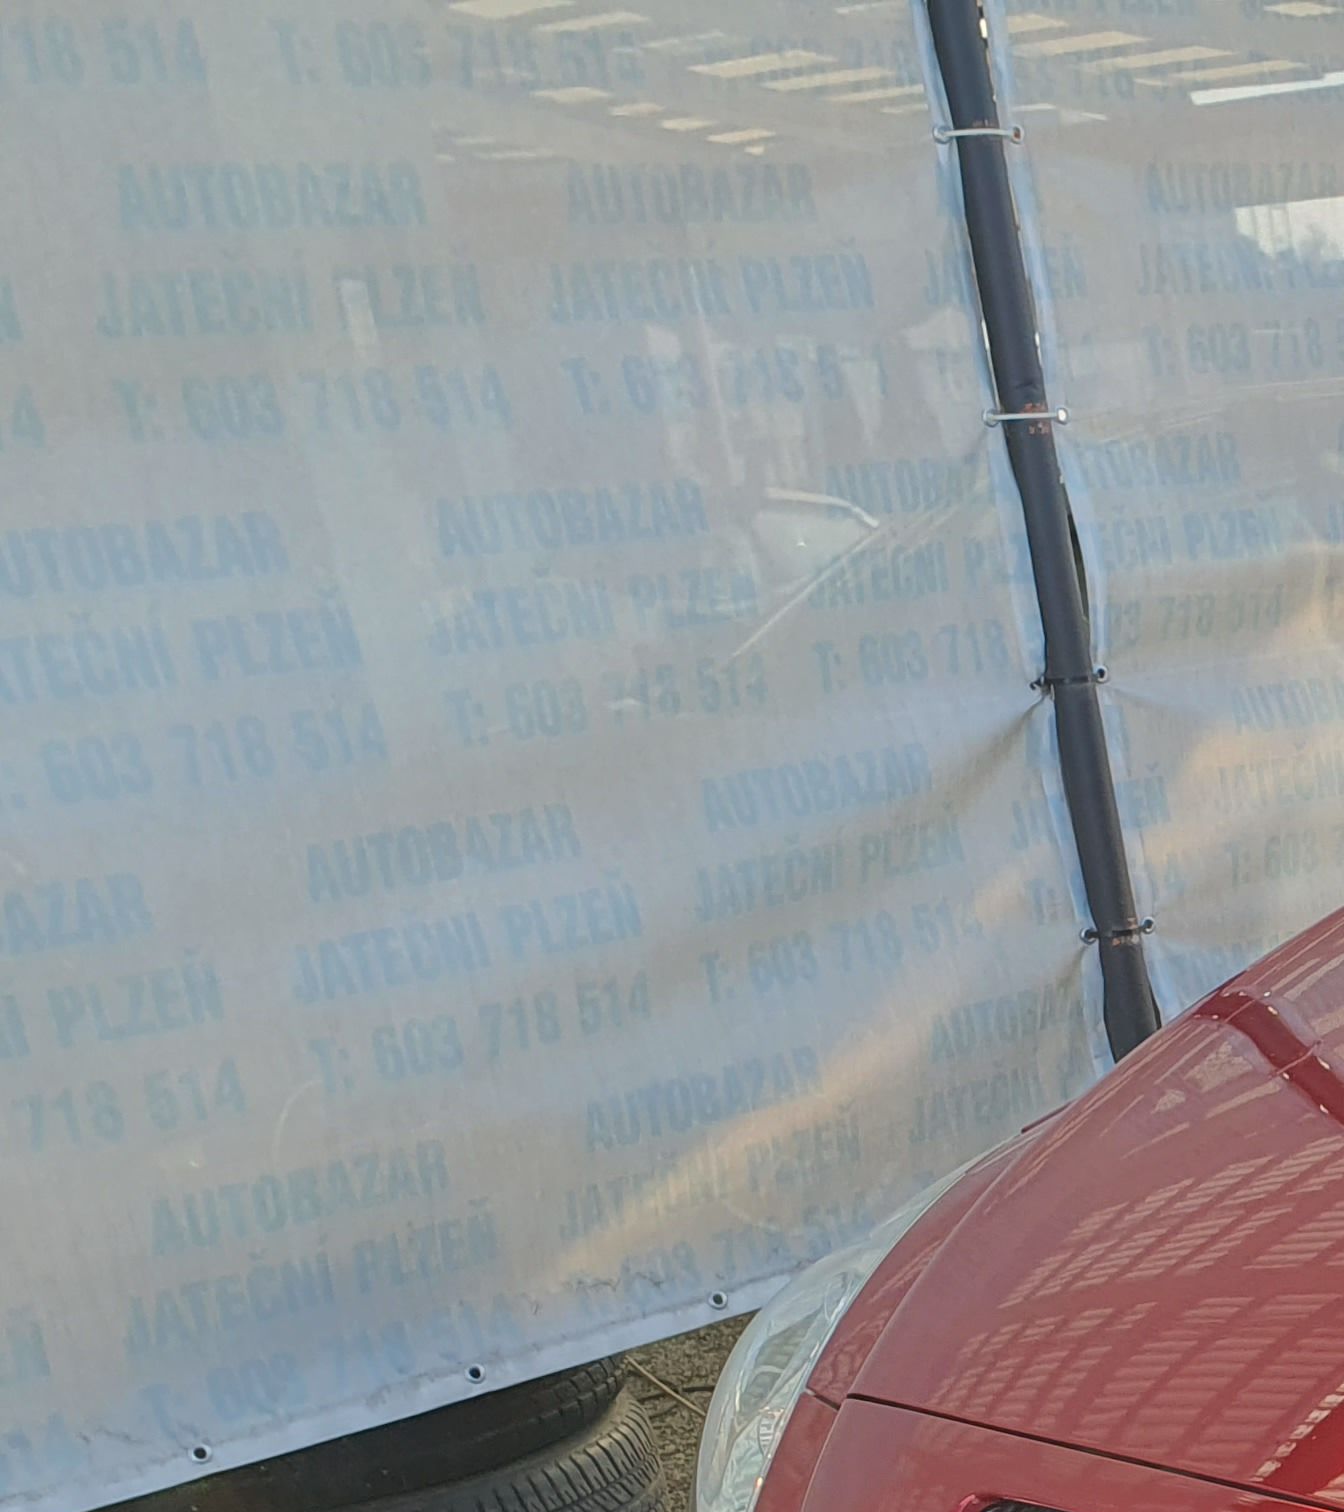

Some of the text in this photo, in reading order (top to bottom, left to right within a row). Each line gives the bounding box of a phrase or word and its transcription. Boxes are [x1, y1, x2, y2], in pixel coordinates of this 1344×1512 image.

[0, 16, 208, 86] 18 514
[268, 18, 320, 86] T:
[335, 18, 432, 89] 603
[117, 160, 430, 230] AUTOBAZAR
[566, 162, 818, 224] AUTOBAZAR
[1187, 323, 1252, 373] 603
[180, 370, 287, 442] 603
[298, 368, 402, 432] 718
[413, 363, 514, 431] 514
[0, 511, 290, 598] UTOBAZAR
[434, 478, 710, 558] AUTOBAZAR
[192, 582, 363, 680] PLZEŇ
[860, 628, 930, 688] 603
[504, 675, 587, 741] 603
[695, 652, 770, 714] 514
[40, 732, 153, 804] 603
[168, 715, 277, 787] 718
[289, 702, 390, 773] 514
[702, 742, 930, 832] AUTOBAZAR
[307, 806, 582, 902] AUTOBAZAR
[1265, 828, 1320, 880] 603
[502, 867, 644, 958] PLZEŇ
[748, 930, 820, 994] 603
[828, 910, 903, 974] 718
[47, 948, 223, 1048] PLZEŇ
[307, 969, 652, 1095] T: 603 718 514
[15, 1056, 247, 1152] 718 514
[585, 1045, 820, 1152] AUTOBAZAR
[150, 1139, 450, 1257] AUTOBAZAR
